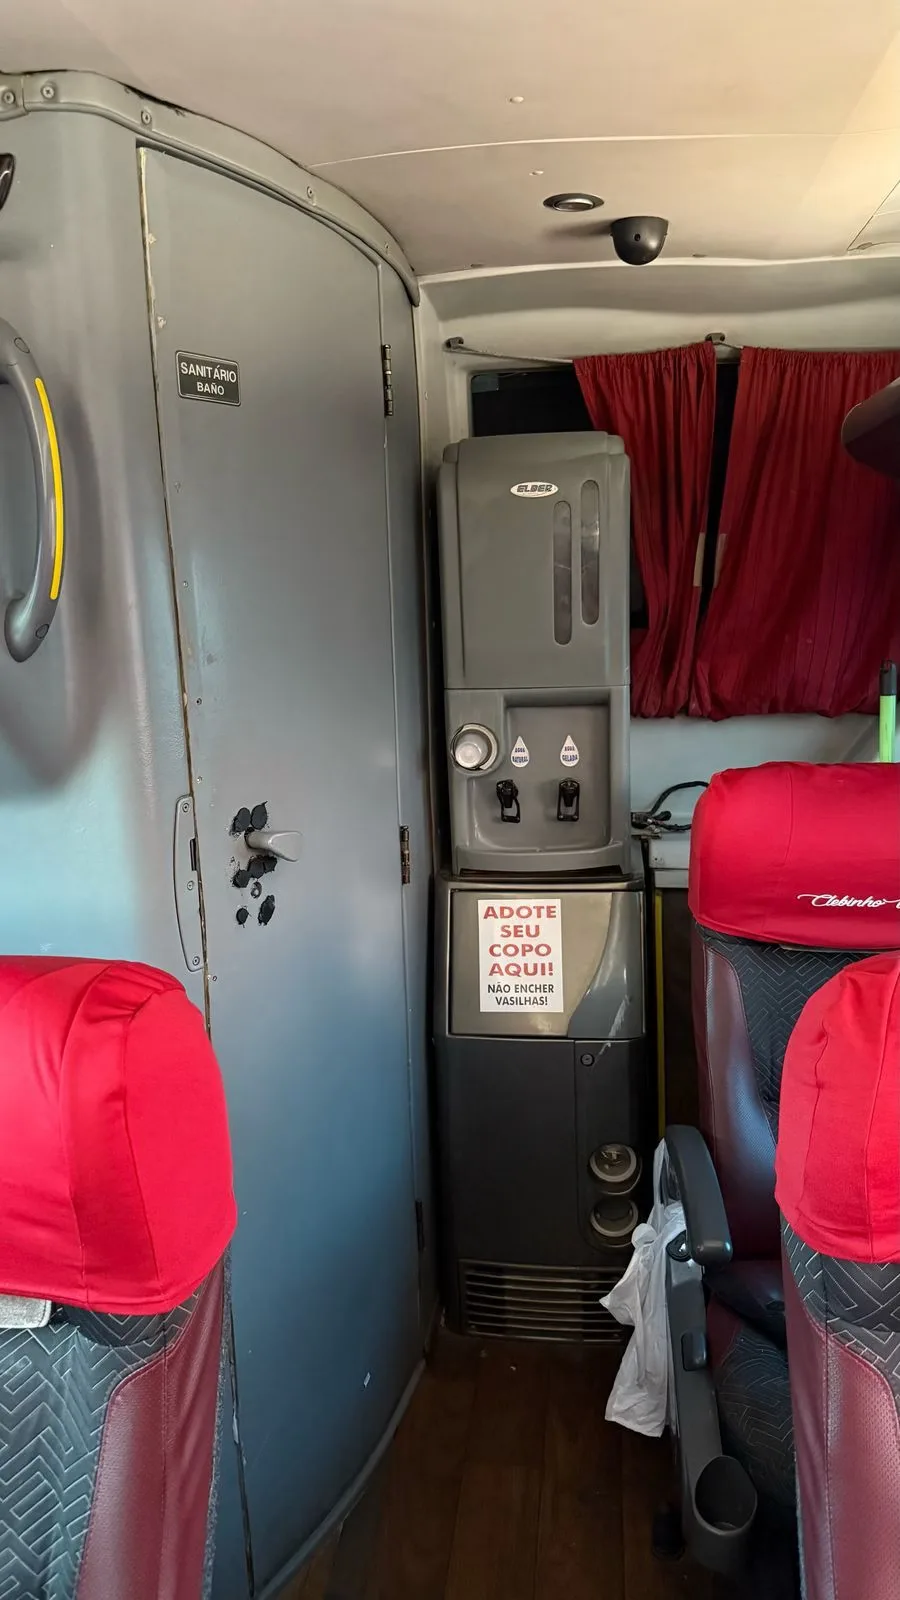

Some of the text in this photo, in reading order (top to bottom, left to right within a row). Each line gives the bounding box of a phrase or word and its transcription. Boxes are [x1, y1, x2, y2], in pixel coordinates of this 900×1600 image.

[180, 362, 237, 383] SANITÁRIO
[197, 381, 225, 396] BAÑO
[797, 893, 886, 908] Clebinho
[483, 905, 557, 919] ADOTE
[500, 924, 540, 938] SEU
[488, 943, 552, 957] COPO
[488, 962, 554, 977] AQUI!
[487, 982, 555, 993] NÃO ENCHER
[495, 996, 548, 1006] VASILHAS!
